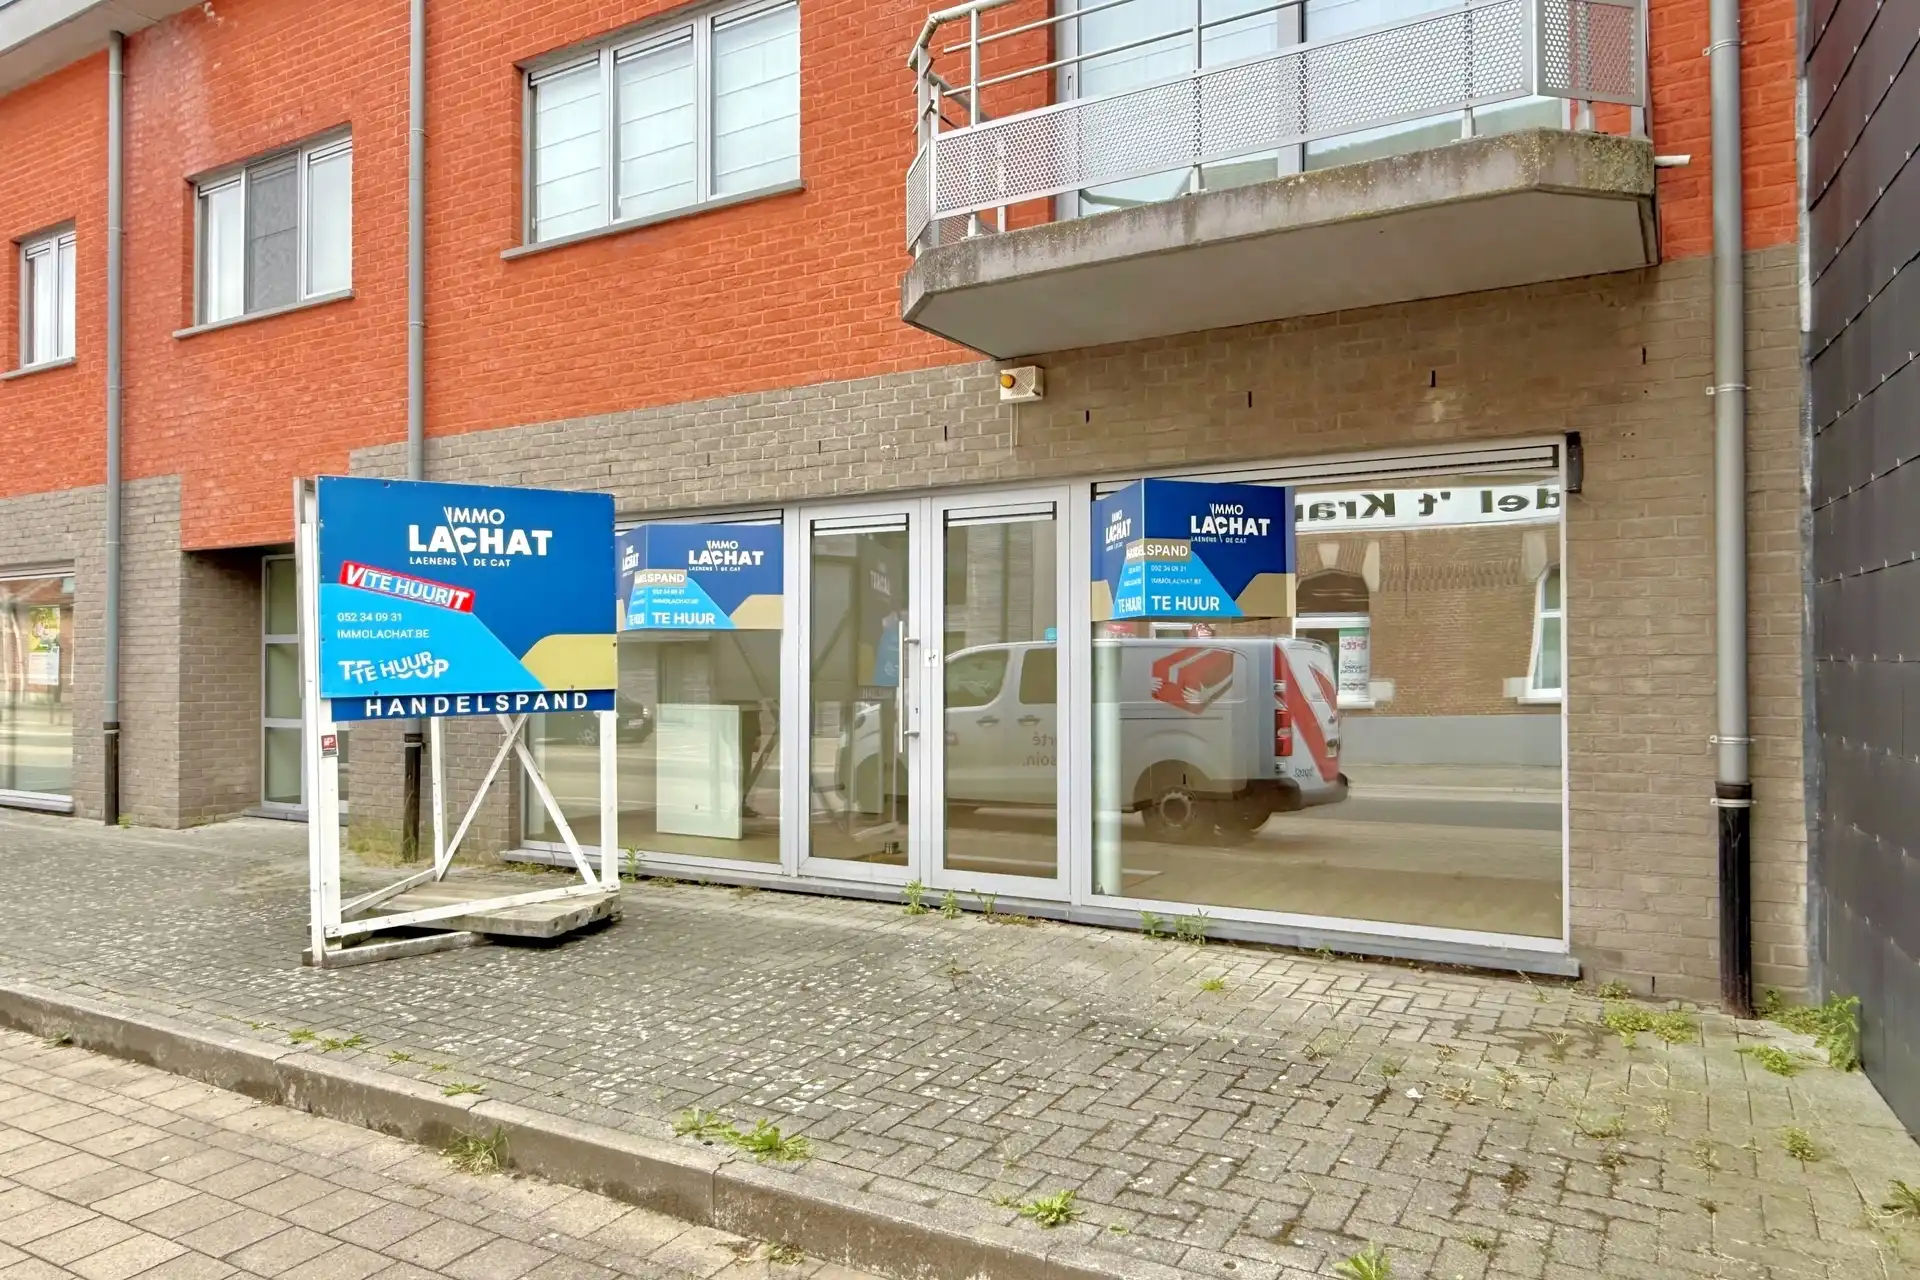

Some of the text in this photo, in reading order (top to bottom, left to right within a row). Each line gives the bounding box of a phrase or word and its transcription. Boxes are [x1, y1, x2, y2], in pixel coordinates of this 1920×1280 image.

[446, 507, 505, 525] IMMO
[1211, 503, 1243, 515] IMMO
[1105, 518, 1131, 544] LACHAT
[1190, 515, 1271, 536] LACHAT
[408, 524, 553, 556] LACHAT
[707, 540, 739, 550] IMMO
[409, 556, 511, 567] LAENENS DE CAT
[688, 550, 765, 566] LACHAT
[1151, 596, 1220, 611] TE HUUR
[336, 612, 402, 622] 052 34 09 31
[652, 612, 671, 625] TE
[674, 612, 716, 625] HUUR
[336, 629, 430, 639] IMMOLACHAT.BE
[365, 692, 588, 717] HANDELSPAND
